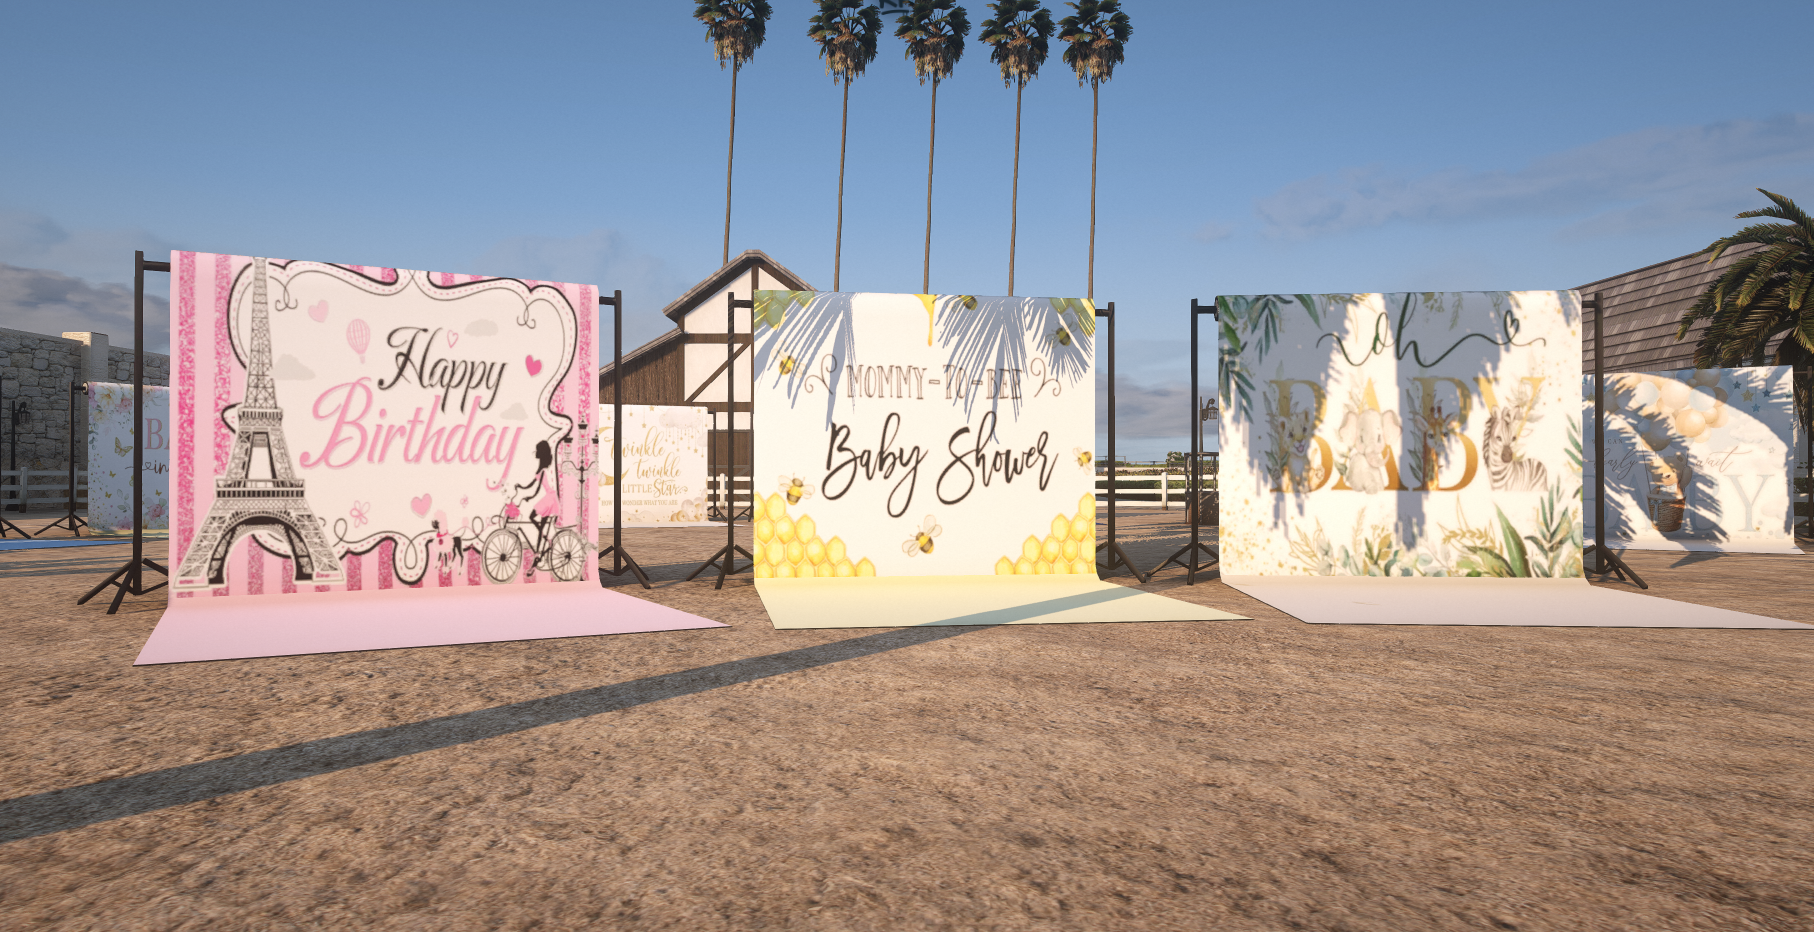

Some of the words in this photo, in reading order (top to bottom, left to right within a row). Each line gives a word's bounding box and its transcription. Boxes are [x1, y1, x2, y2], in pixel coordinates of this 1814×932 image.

[377, 326, 508, 414] Happy
[845, 364, 1023, 400] MOMMY-TO-BEE
[144, 417, 170, 450] B
[299, 376, 525, 491] Birthday
[632, 452, 682, 479] twinkle
[821, 412, 929, 518] Baby
[936, 410, 1059, 505] Shower
[1695, 445, 1753, 473] wait
[622, 483, 653, 494] LITTLE
[653, 478, 688, 499] Star
